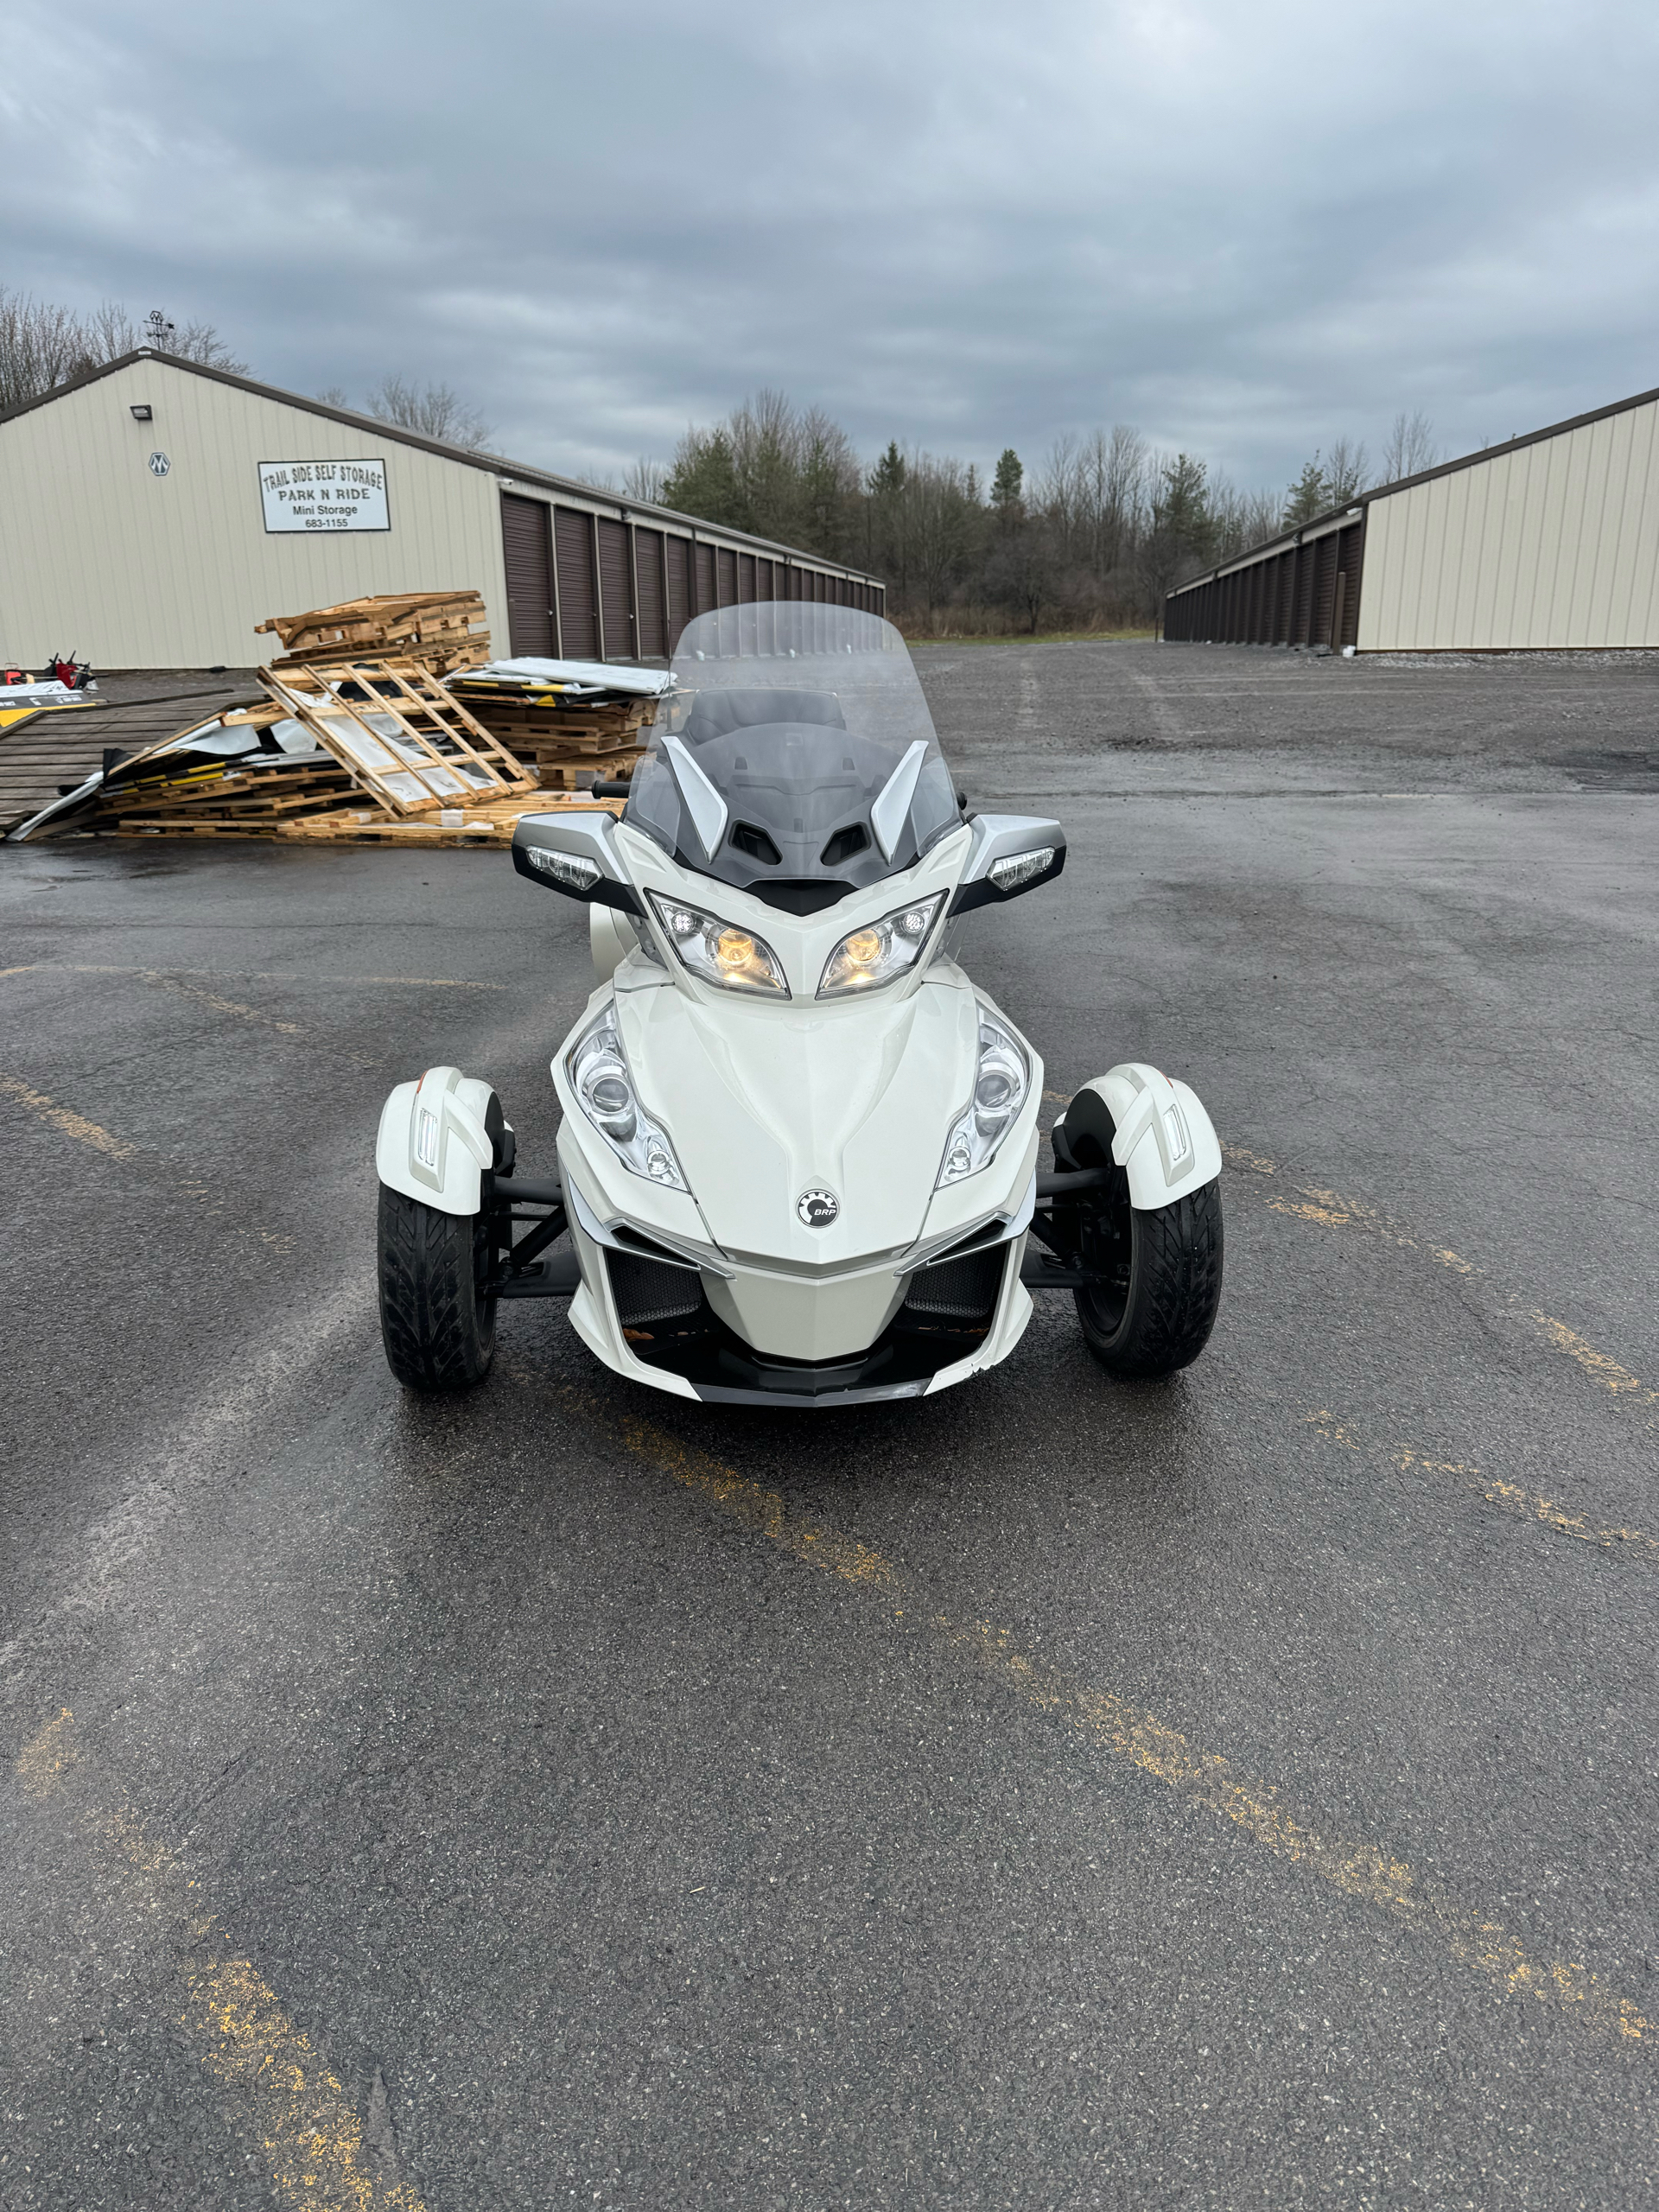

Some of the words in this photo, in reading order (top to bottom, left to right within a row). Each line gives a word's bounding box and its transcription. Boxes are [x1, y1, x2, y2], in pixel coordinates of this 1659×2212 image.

[263, 470, 290, 493] TRAIL
[292, 466, 314, 484] SIDE
[315, 465, 337, 481] SELF
[340, 466, 383, 491] STORAGE
[278, 489, 316, 501] PARK
[321, 489, 330, 500] N
[336, 488, 371, 500] RIDE
[293, 505, 315, 515] Mini
[317, 505, 358, 517] Storage
[305, 518, 348, 528] 683-1155
